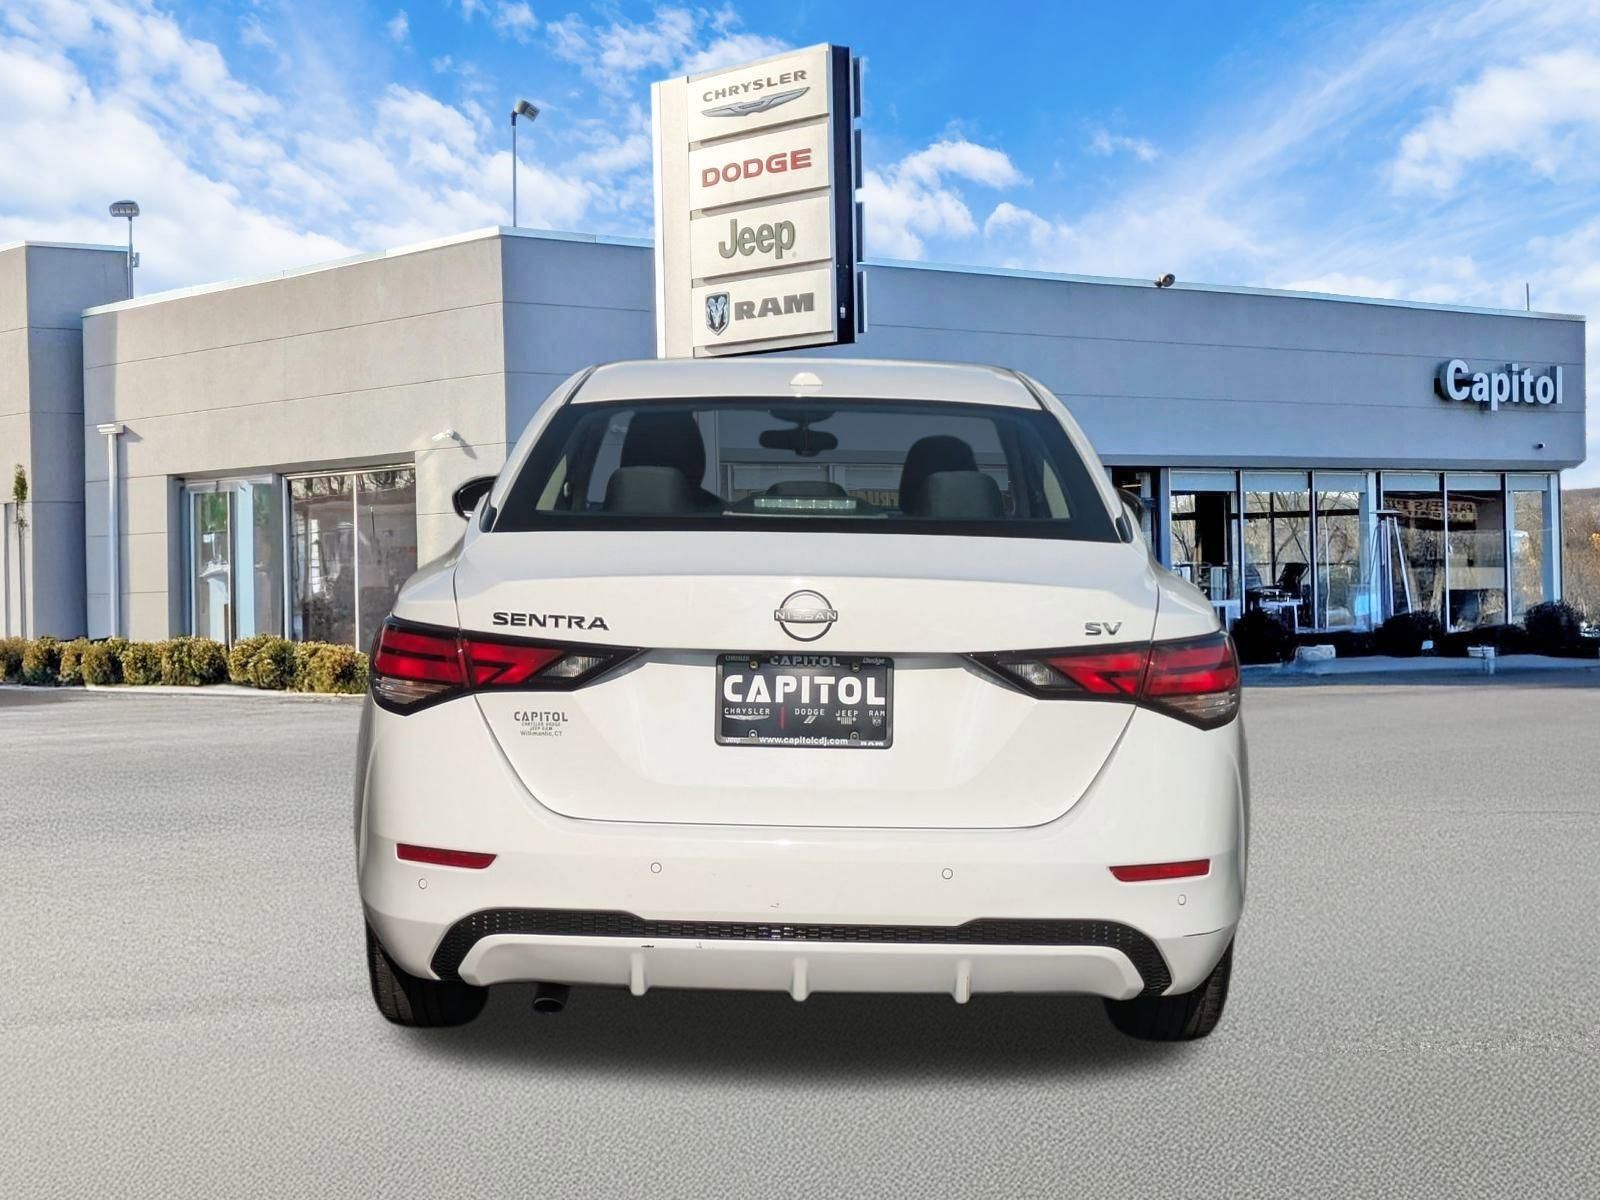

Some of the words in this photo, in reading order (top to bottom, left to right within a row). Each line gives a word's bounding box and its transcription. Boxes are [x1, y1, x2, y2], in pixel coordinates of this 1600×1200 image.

[702, 69, 808, 103] CHRYSLER
[702, 148, 812, 188] DODGE
[718, 218, 796, 260] Jeep
[734, 292, 815, 321] RAM
[1445, 358, 1563, 412] Capitol
[492, 611, 610, 631] SENTRA
[1084, 622, 1123, 636] SV
[769, 655, 841, 667] CAPITOL
[723, 674, 886, 705] CAPITOL
[513, 711, 569, 722] CAPITOL
[724, 707, 770, 715] CHRYSLER
[794, 708, 825, 716] DODGE
[835, 709, 859, 717] JEEP
[868, 709, 886, 717] RAM
[758, 735, 849, 746] www.capitolcdj.com
